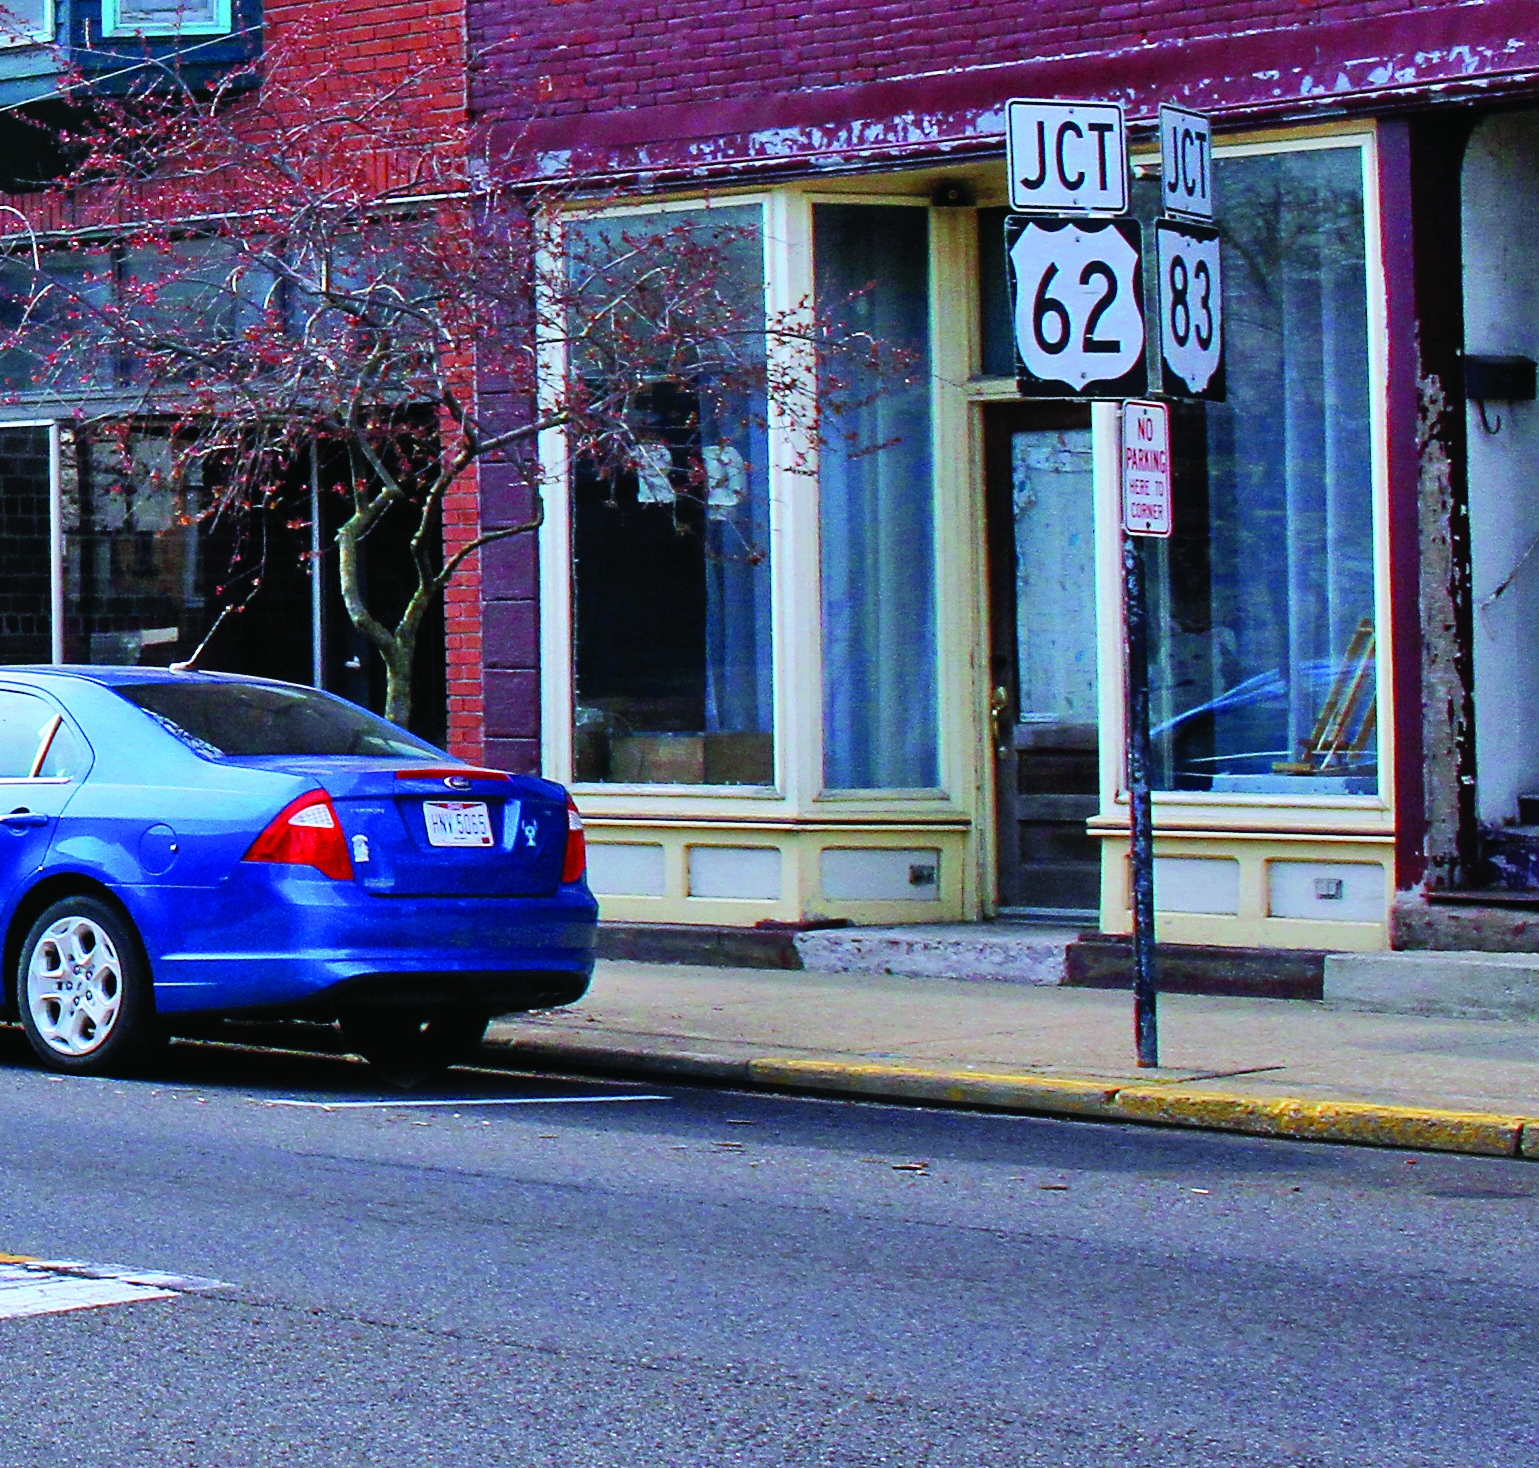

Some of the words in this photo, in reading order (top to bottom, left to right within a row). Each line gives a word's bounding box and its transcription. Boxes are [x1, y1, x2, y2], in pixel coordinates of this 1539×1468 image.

[1020, 120, 1113, 191] JCT
[1168, 126, 1207, 199] JCT
[1033, 260, 1120, 355] 62
[1170, 254, 1212, 351] 83
[1137, 417, 1153, 441] NO
[1125, 447, 1167, 473] PARKING
[1129, 478, 1150, 496] HERE
[1155, 480, 1164, 496] TO
[1131, 502, 1163, 519] CORNER
[456, 812, 487, 835] 5065
